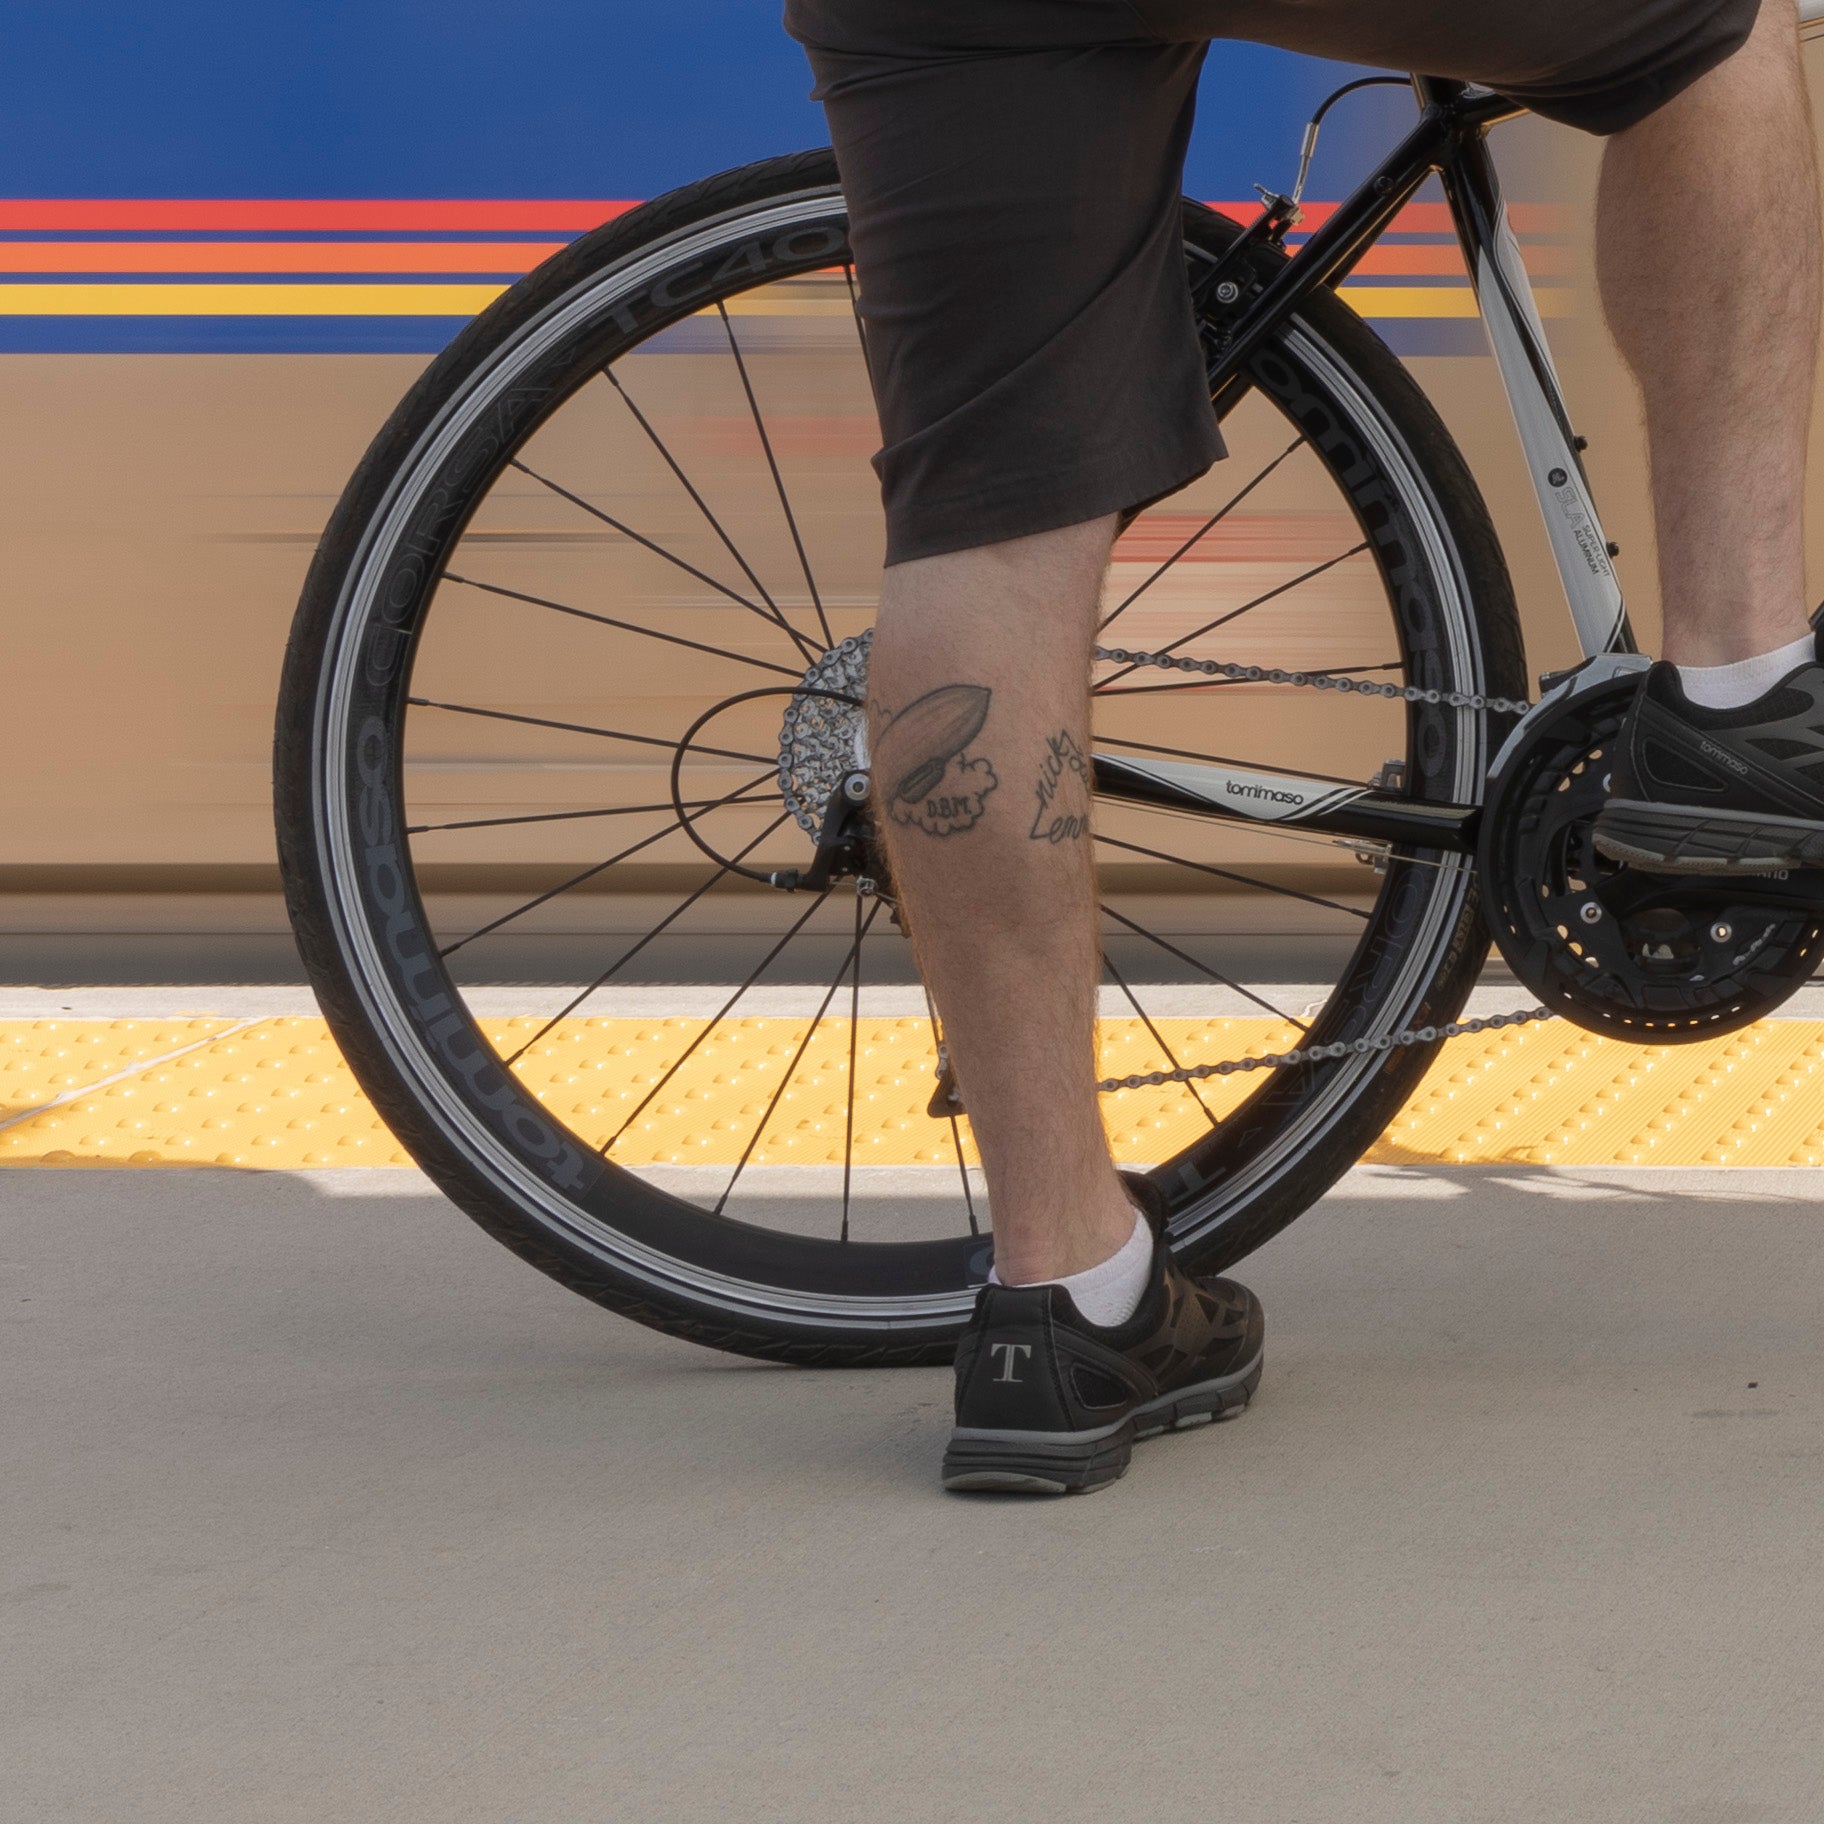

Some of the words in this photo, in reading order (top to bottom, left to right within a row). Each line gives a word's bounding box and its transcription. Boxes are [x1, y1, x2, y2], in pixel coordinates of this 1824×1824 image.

[1700, 740, 1749, 775] tommaso
[1225, 779, 1304, 805] tommaso
[358, 717, 585, 1191] tommaso
[991, 1342, 1032, 1384] T
